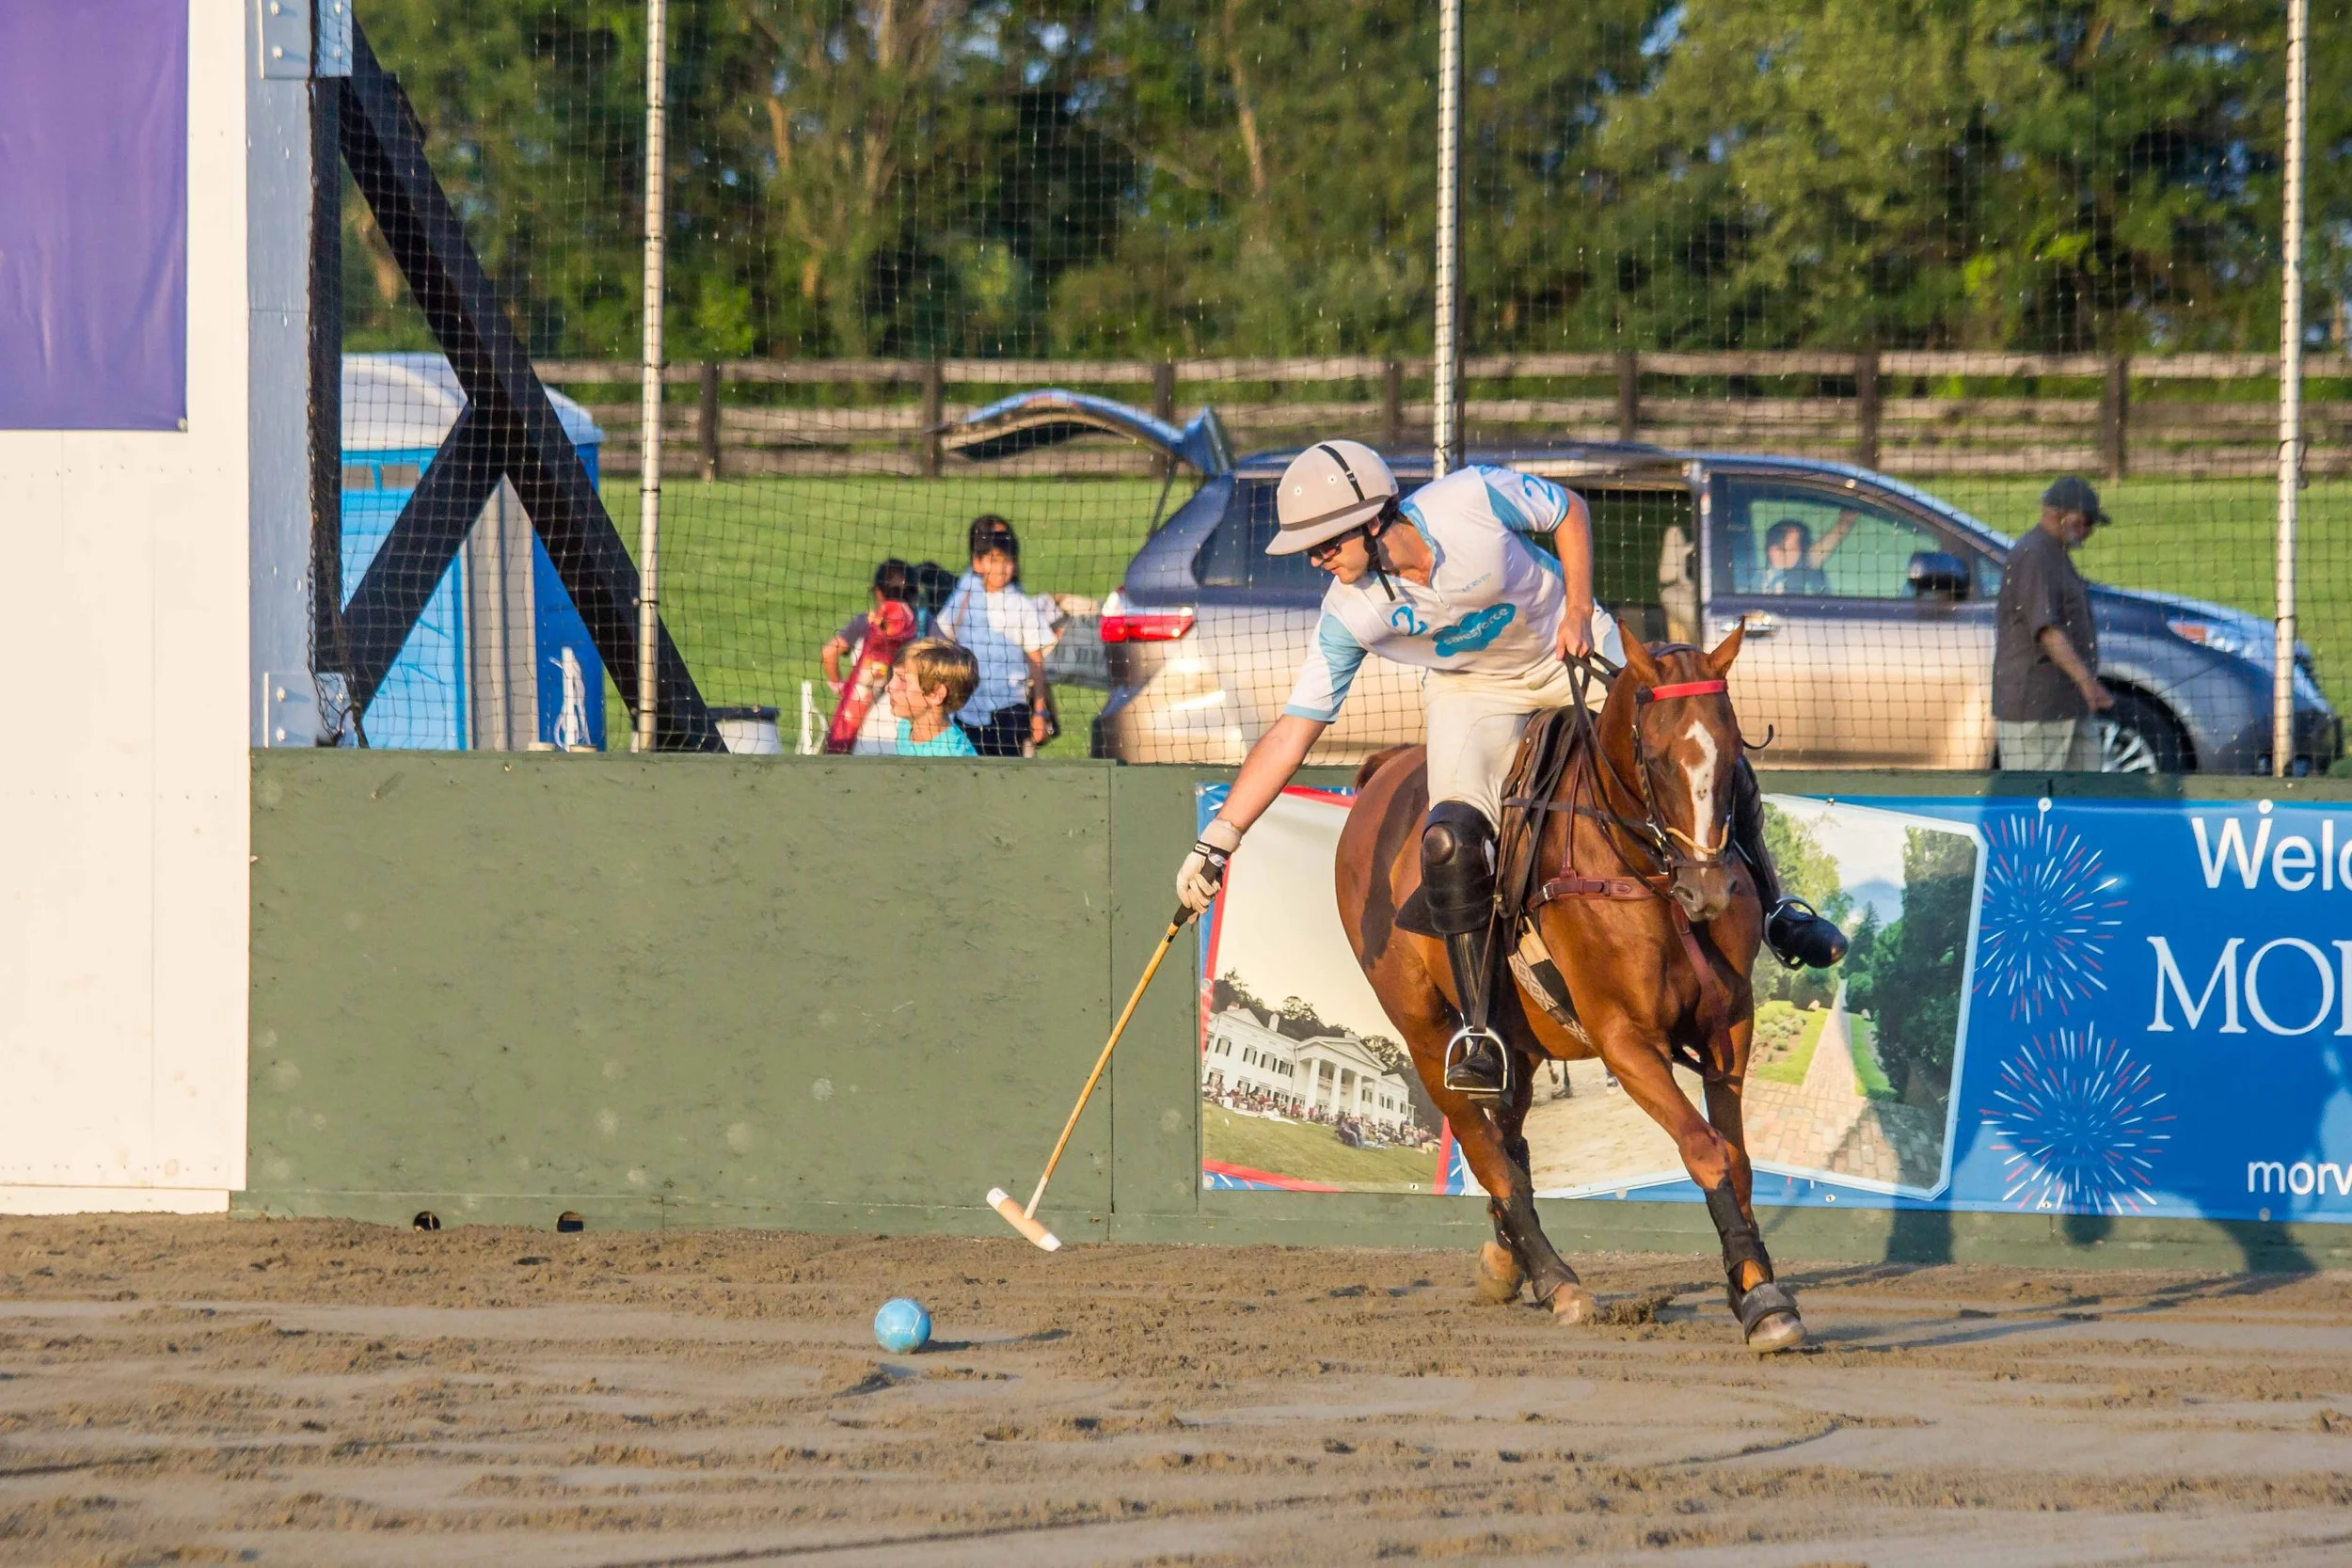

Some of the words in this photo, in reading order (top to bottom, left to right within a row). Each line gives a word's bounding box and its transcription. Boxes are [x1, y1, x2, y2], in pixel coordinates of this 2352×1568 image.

[1522, 473, 1555, 505] 2
[1391, 606, 1428, 636] 2
[1443, 608, 1509, 645] salesforce
[2146, 936, 2352, 1036] MO
